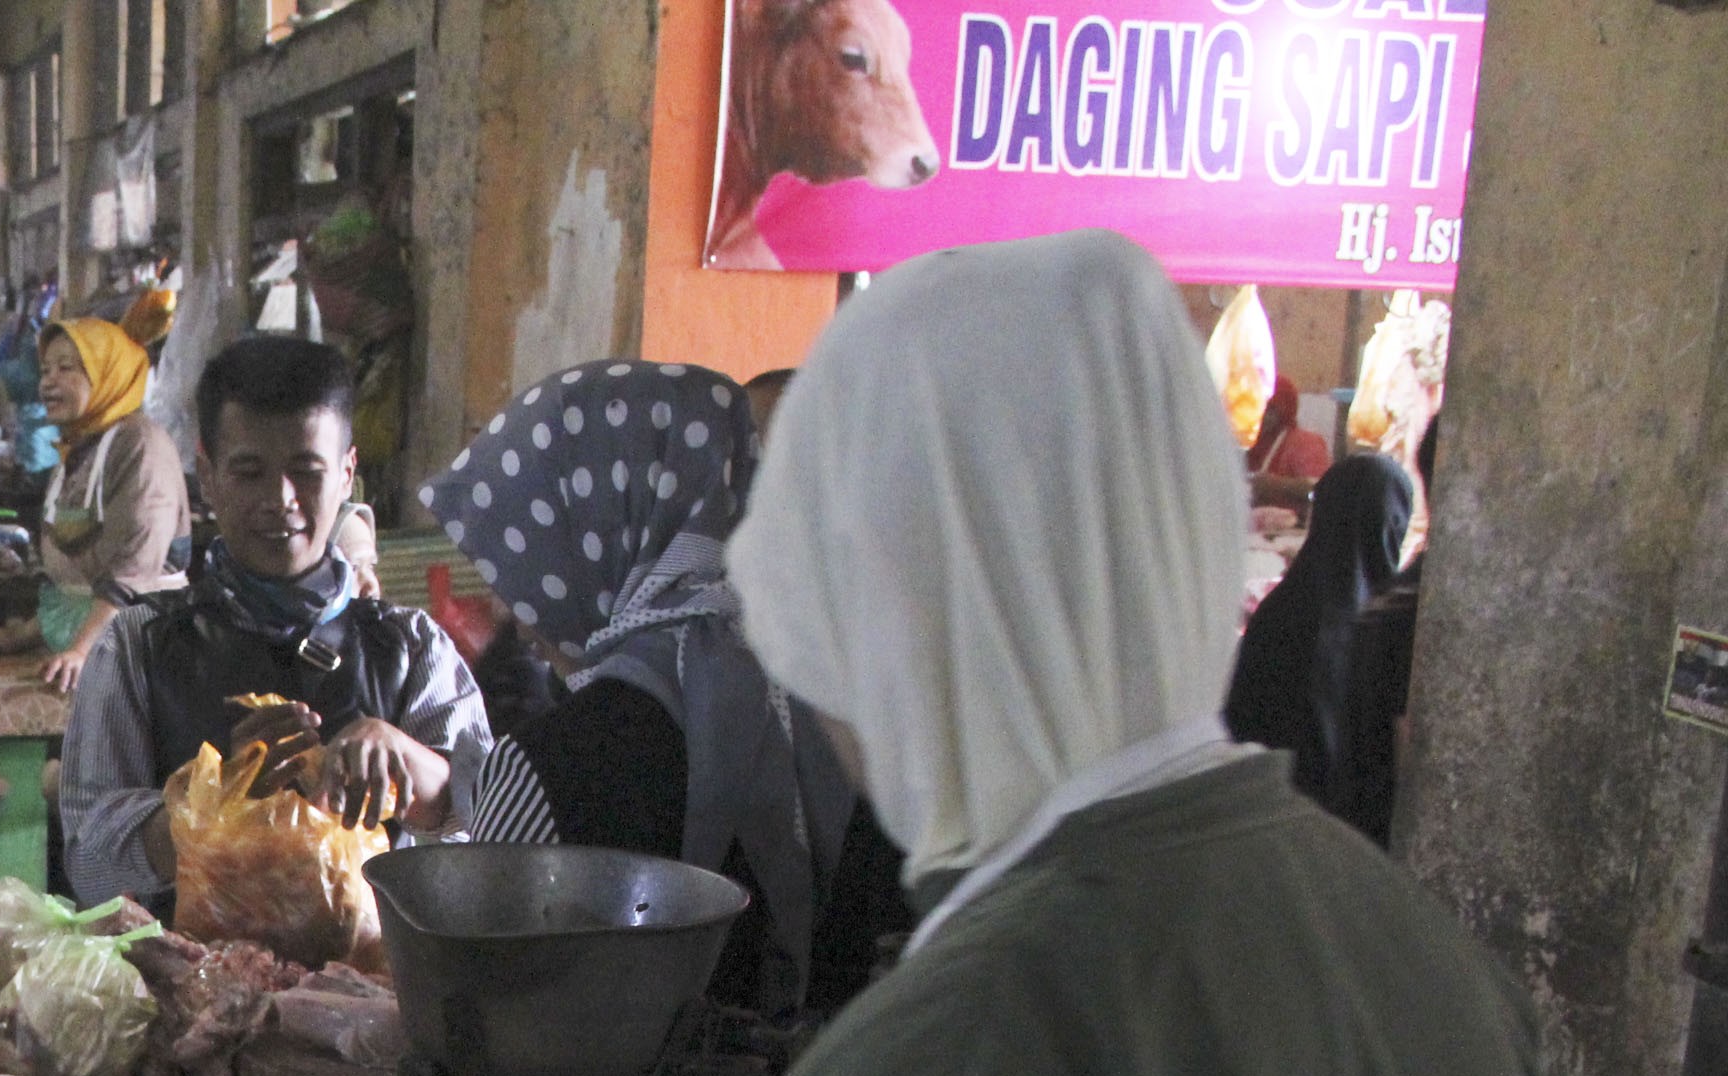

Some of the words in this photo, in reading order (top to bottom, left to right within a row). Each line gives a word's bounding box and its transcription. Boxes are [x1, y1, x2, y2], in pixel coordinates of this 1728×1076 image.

[950, 14, 1251, 181] DAGING
[1265, 29, 1458, 188] SAPI
[1335, 202, 1398, 275] Hj.
